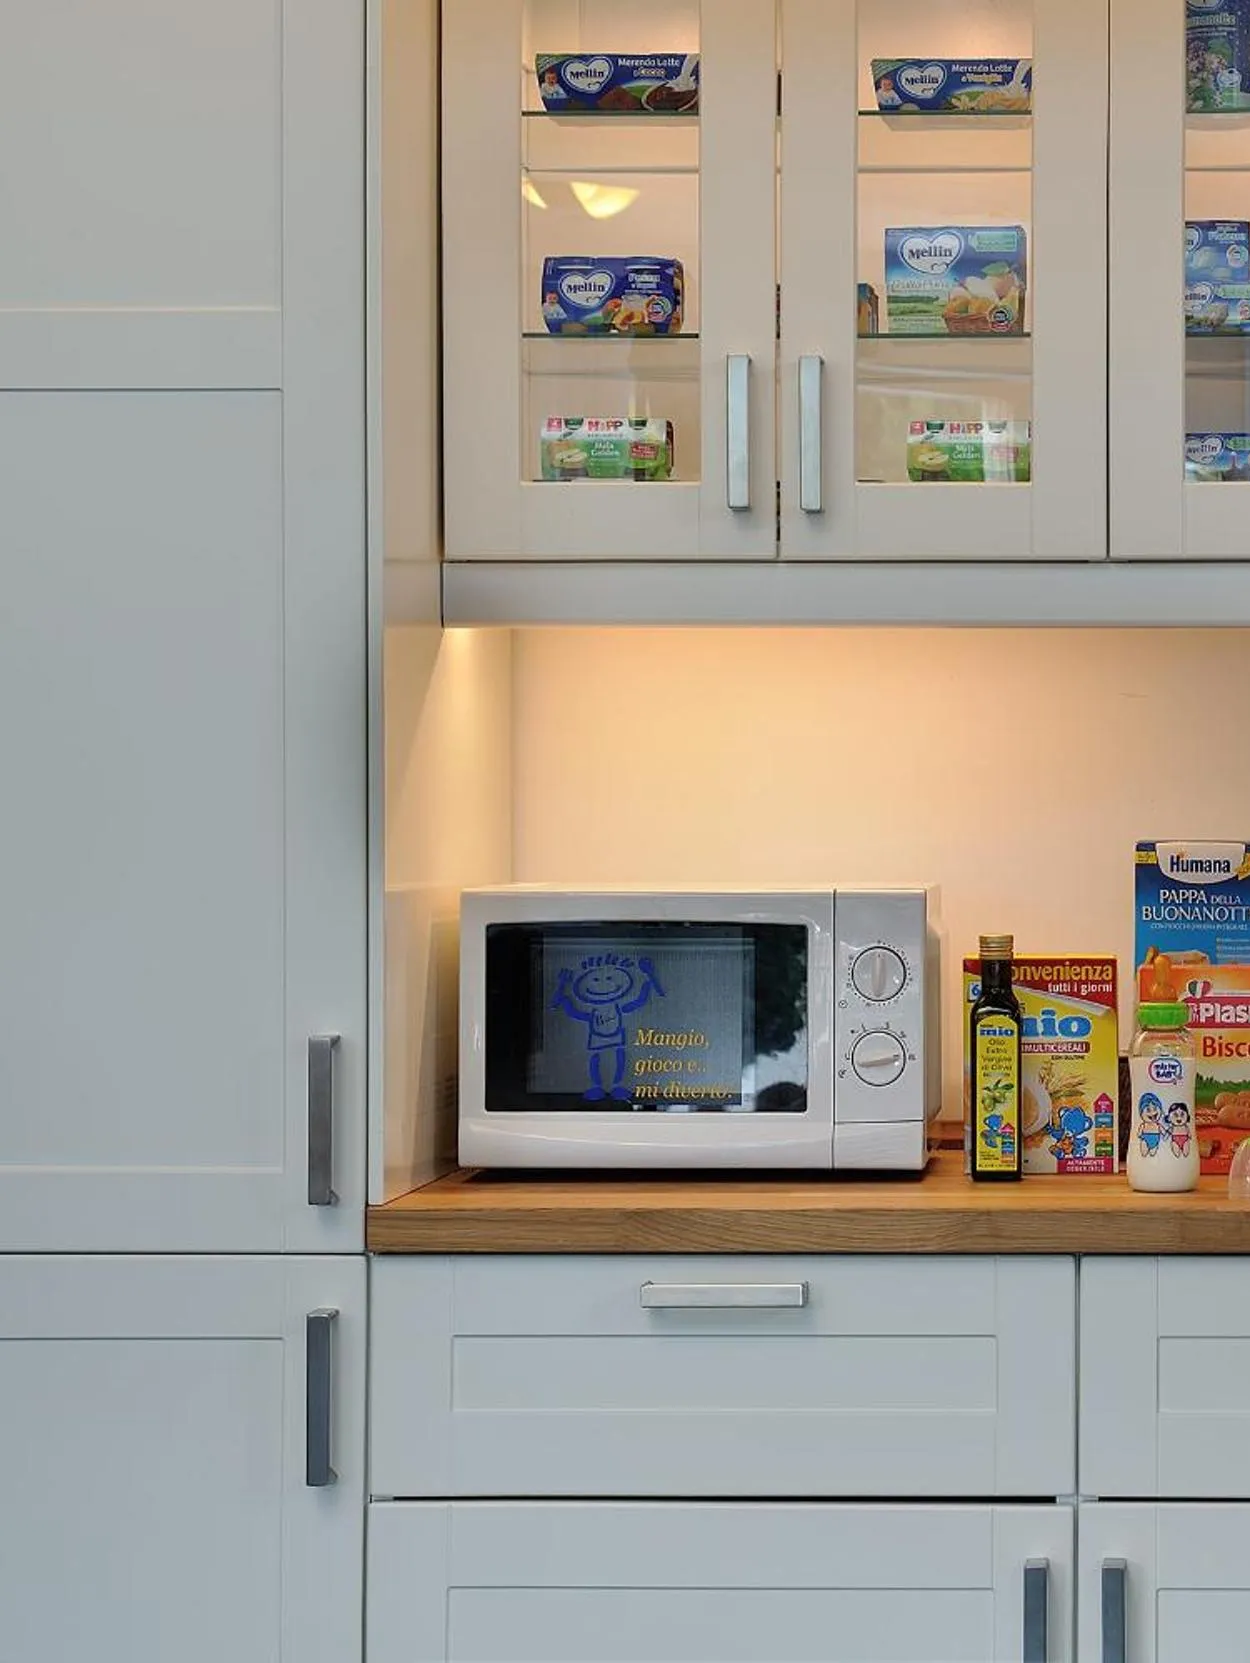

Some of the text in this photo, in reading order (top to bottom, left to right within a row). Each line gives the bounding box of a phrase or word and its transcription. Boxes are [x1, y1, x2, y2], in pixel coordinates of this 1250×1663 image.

[618, 58, 680, 68] Merenda Latte
[951, 64, 1013, 73] Merenda Latte
[569, 69, 605, 80] Mellin
[904, 75, 940, 86] Mellin
[908, 245, 953, 259] Mellin
[566, 282, 605, 294] Mellin
[1187, 444, 1218, 455] Mellin
[1169, 855, 1231, 873] Humana
[1160, 889, 1242, 905] PAPPA DELLA
[1047, 981, 1113, 996] tutti i giorni
[979, 1025, 1015, 1037] mio
[634, 1028, 710, 1050] Mangio,
[988, 1038, 1006, 1046] Olio
[634, 1056, 683, 1076] gioco
[635, 1080, 733, 1099] mi diverto.
